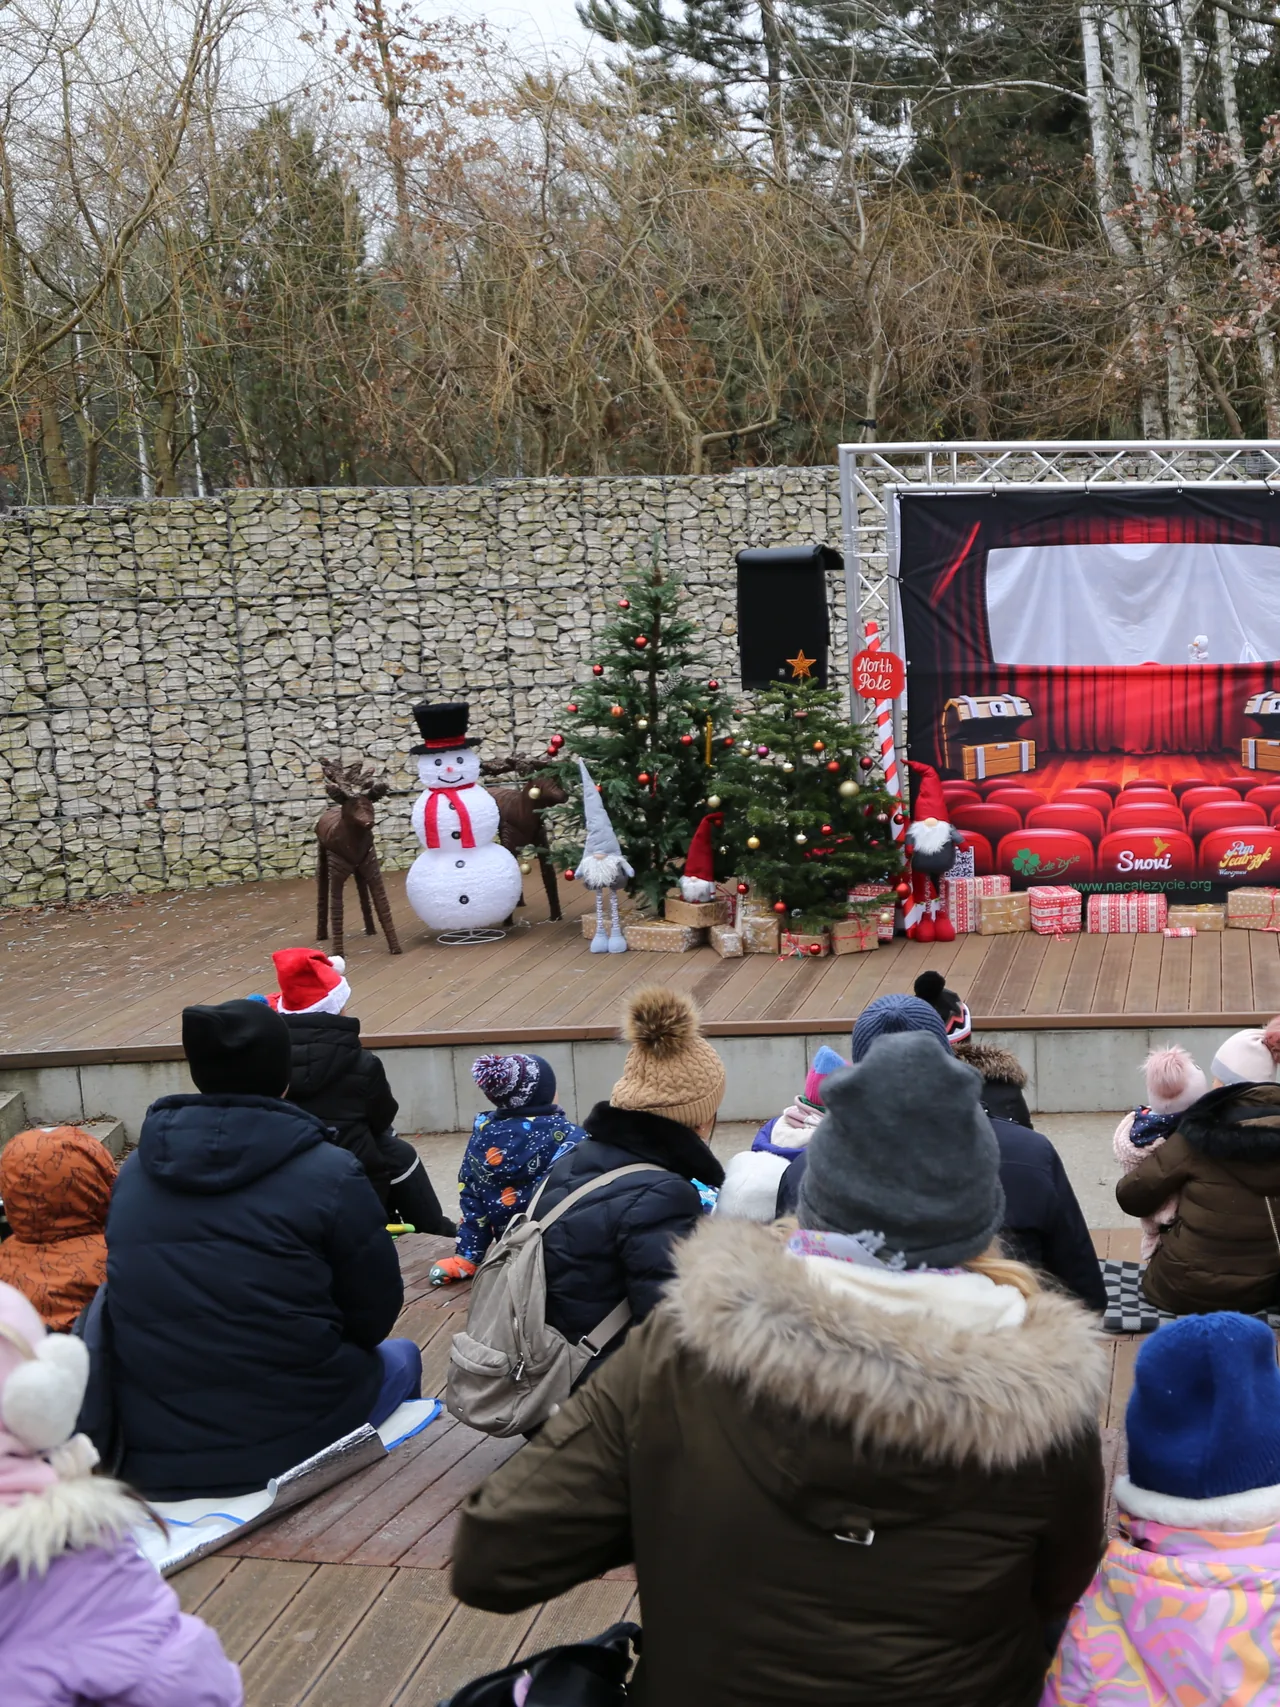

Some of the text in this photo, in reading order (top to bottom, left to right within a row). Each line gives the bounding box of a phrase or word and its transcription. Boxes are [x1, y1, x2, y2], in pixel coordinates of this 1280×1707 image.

[857, 657, 894, 673] North
[857, 672, 892, 691] Pole
[1226, 840, 1255, 856] Pan
[1116, 850, 1173, 873] Snovi
[1069, 879, 1212, 893] www.nacalezycie.org
